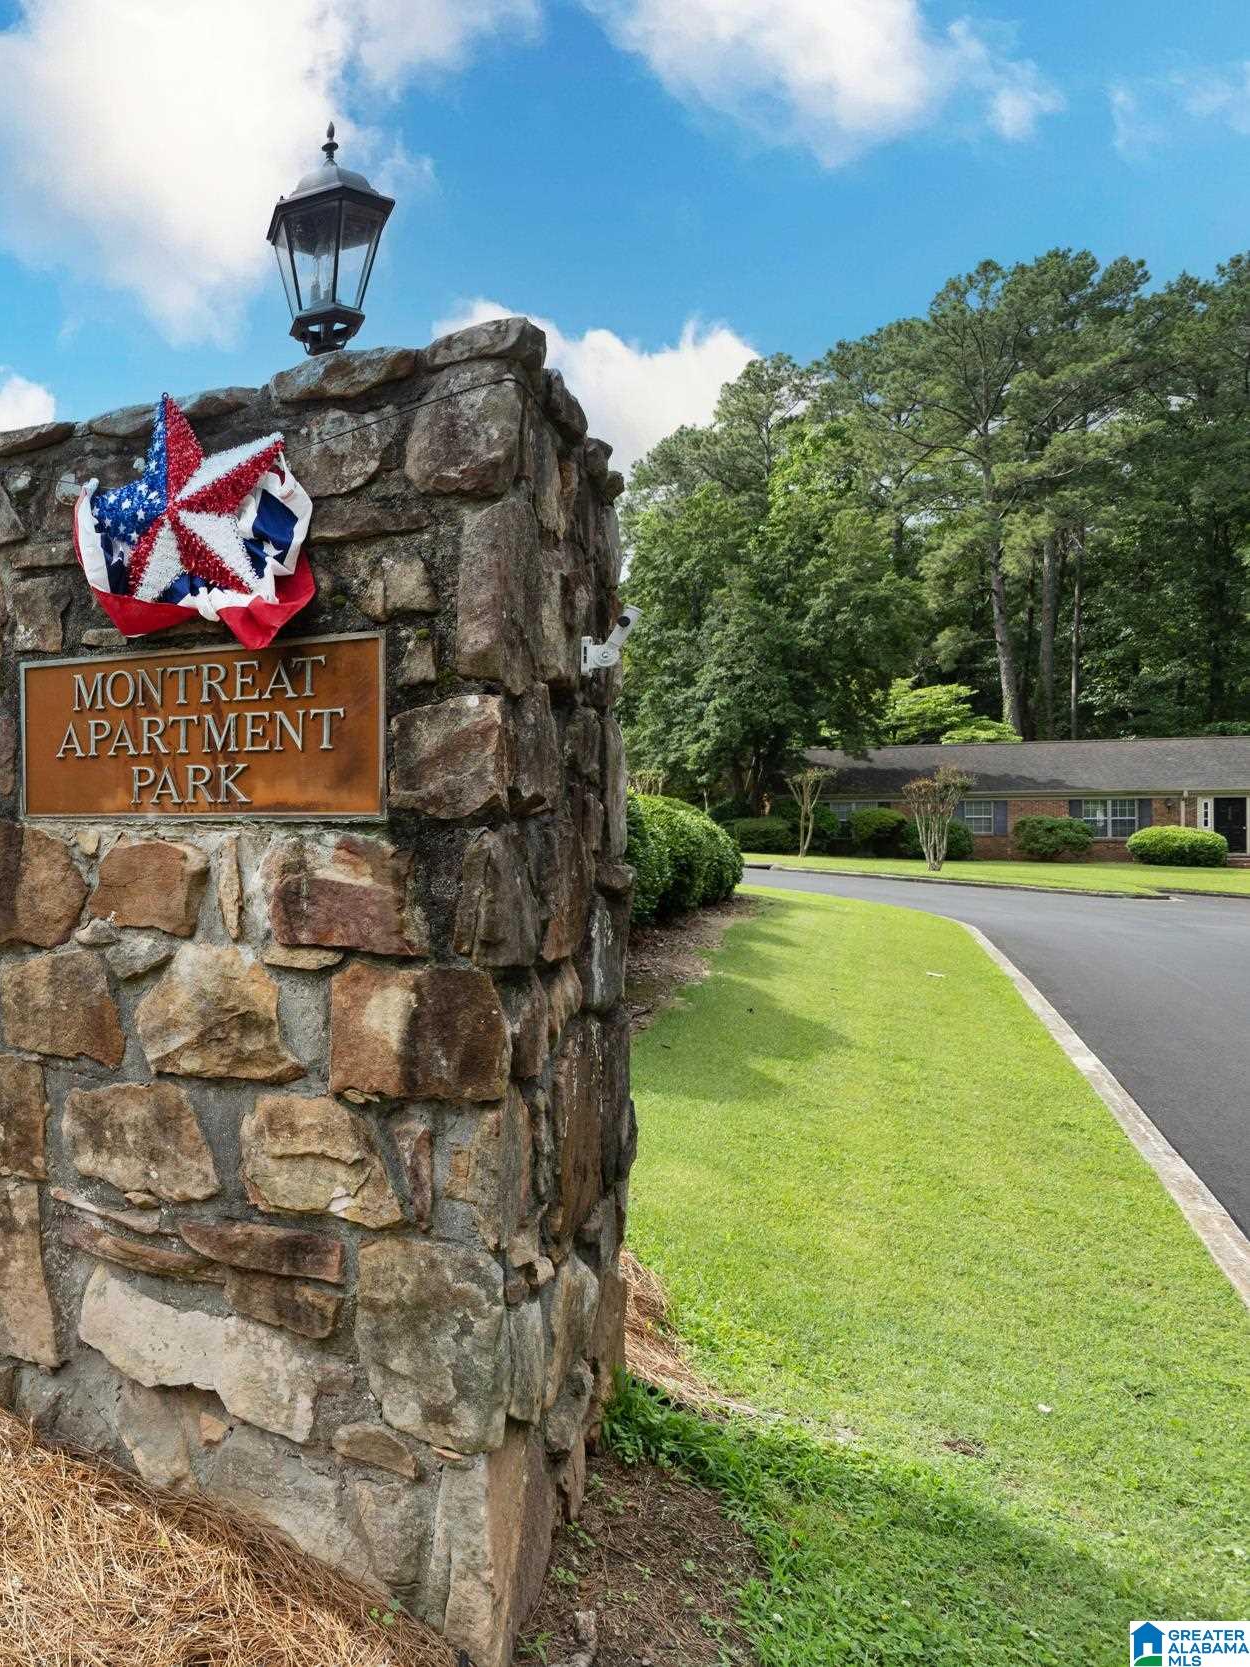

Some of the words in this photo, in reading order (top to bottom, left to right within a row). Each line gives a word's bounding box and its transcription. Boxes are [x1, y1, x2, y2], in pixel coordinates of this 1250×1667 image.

[72, 655, 326, 711] MONTREAT
[56, 707, 345, 759] APARTMENT
[131, 763, 252, 805] PARK
